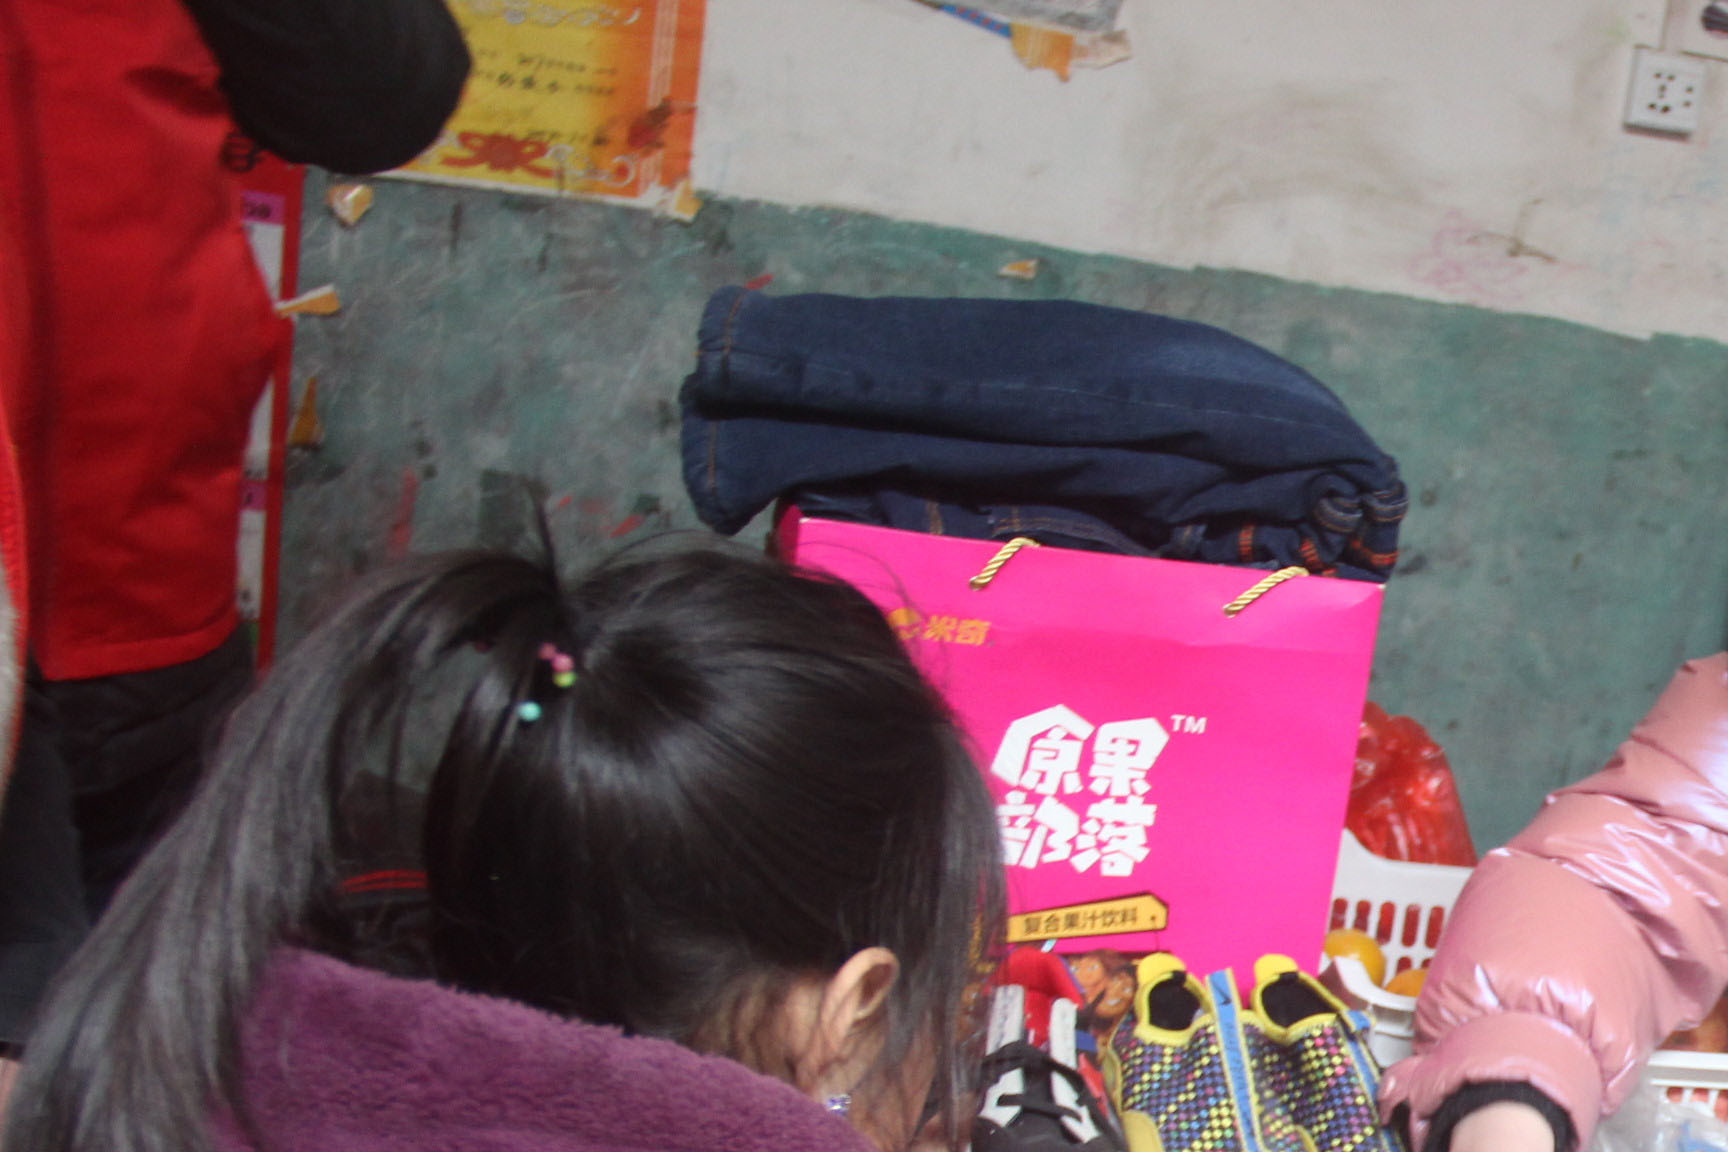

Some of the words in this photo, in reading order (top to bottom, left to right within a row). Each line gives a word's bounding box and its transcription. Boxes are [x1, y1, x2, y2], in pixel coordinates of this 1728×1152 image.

[990, 703, 1170, 796] 原果
[1170, 714, 1208, 734] TM
[994, 789, 1158, 877] 部落
[1023, 905, 1138, 936] 复合果汁饮料
